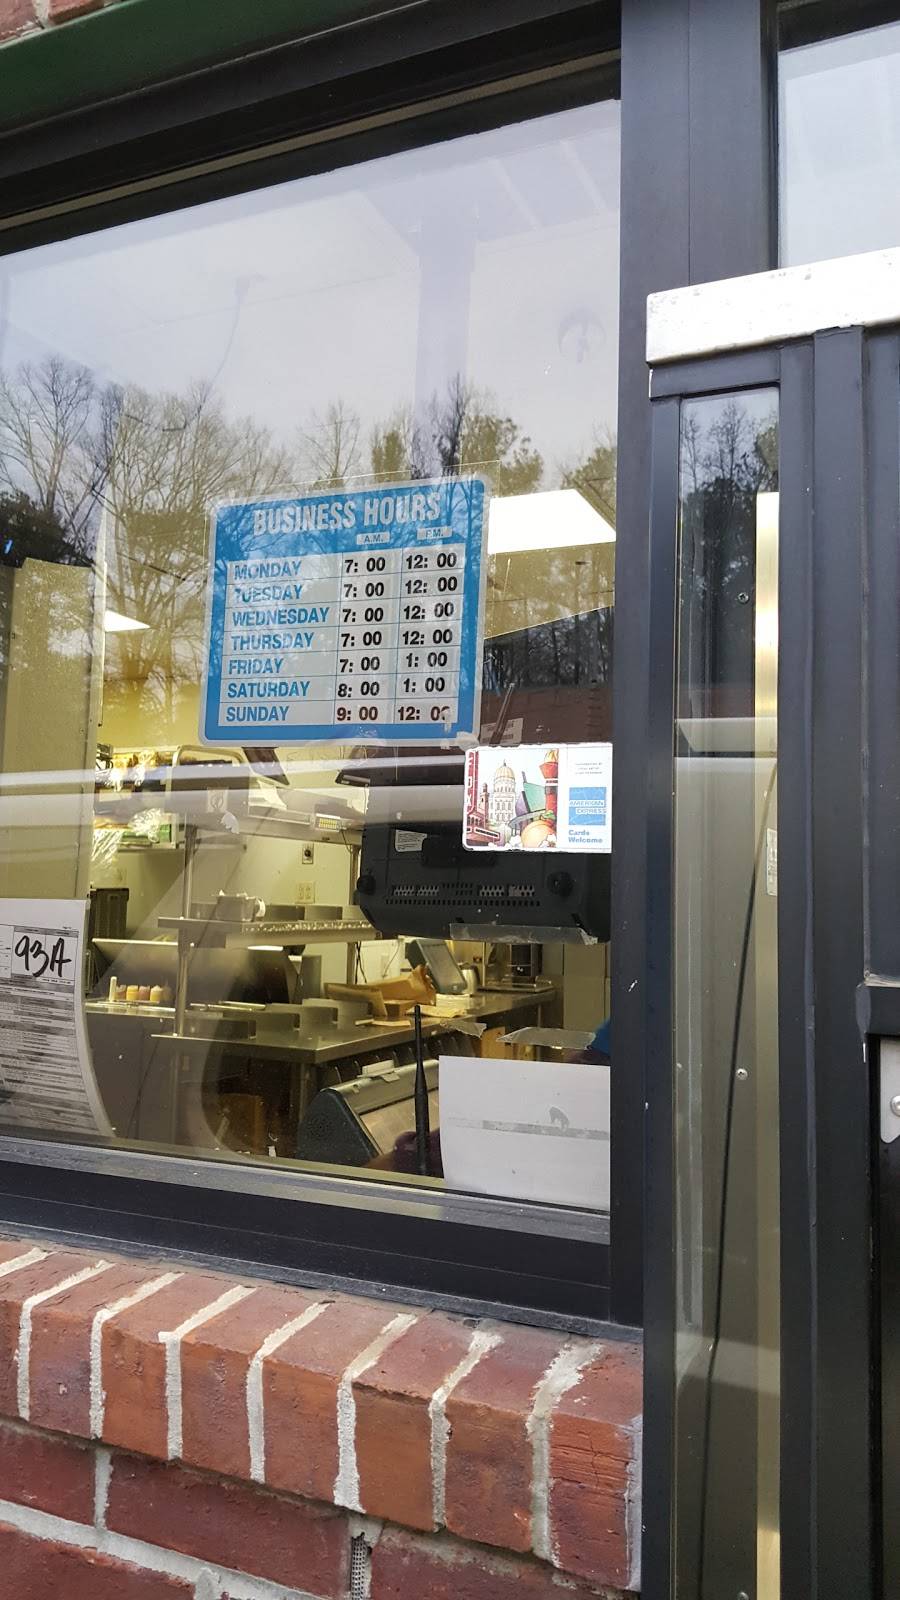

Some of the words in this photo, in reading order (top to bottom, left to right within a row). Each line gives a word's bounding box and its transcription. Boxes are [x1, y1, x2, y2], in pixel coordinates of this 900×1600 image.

[252, 501, 356, 536] BUSINESS
[363, 492, 441, 525] HOURS
[364, 534, 384, 543] A.M.
[234, 560, 302, 580] MONDAY
[232, 607, 330, 627] WEDNESDAY
[230, 632, 315, 651] THURSDAY
[228, 658, 284, 675] FRIDAY
[227, 681, 310, 698] SATURDAY
[226, 706, 290, 722] SUNDAY
[14, 935, 72, 978] 93A
